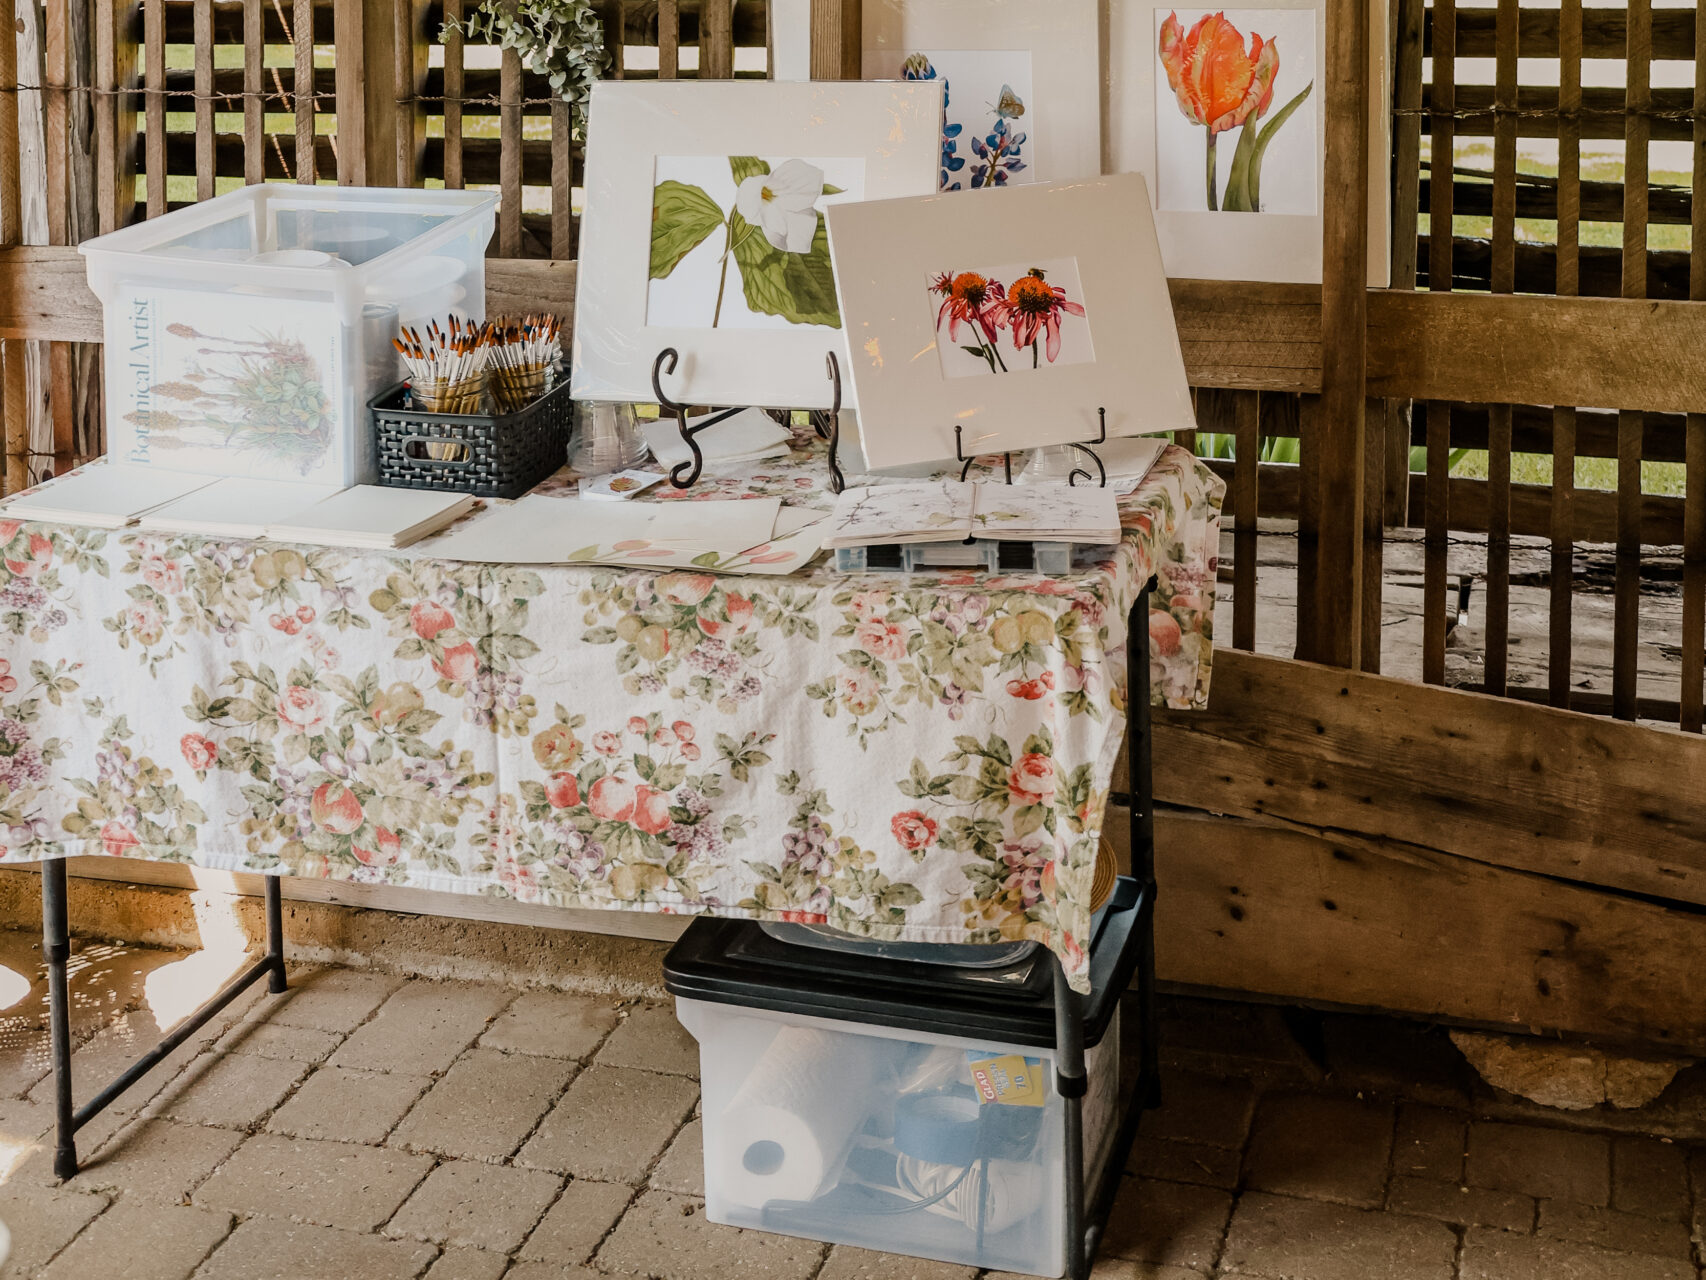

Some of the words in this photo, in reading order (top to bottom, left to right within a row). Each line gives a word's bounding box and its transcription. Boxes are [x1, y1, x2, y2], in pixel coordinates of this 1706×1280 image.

[129, 298, 149, 359] Artist
[129, 363, 150, 463] Botanical
[976, 1071, 995, 1100] GLAD
